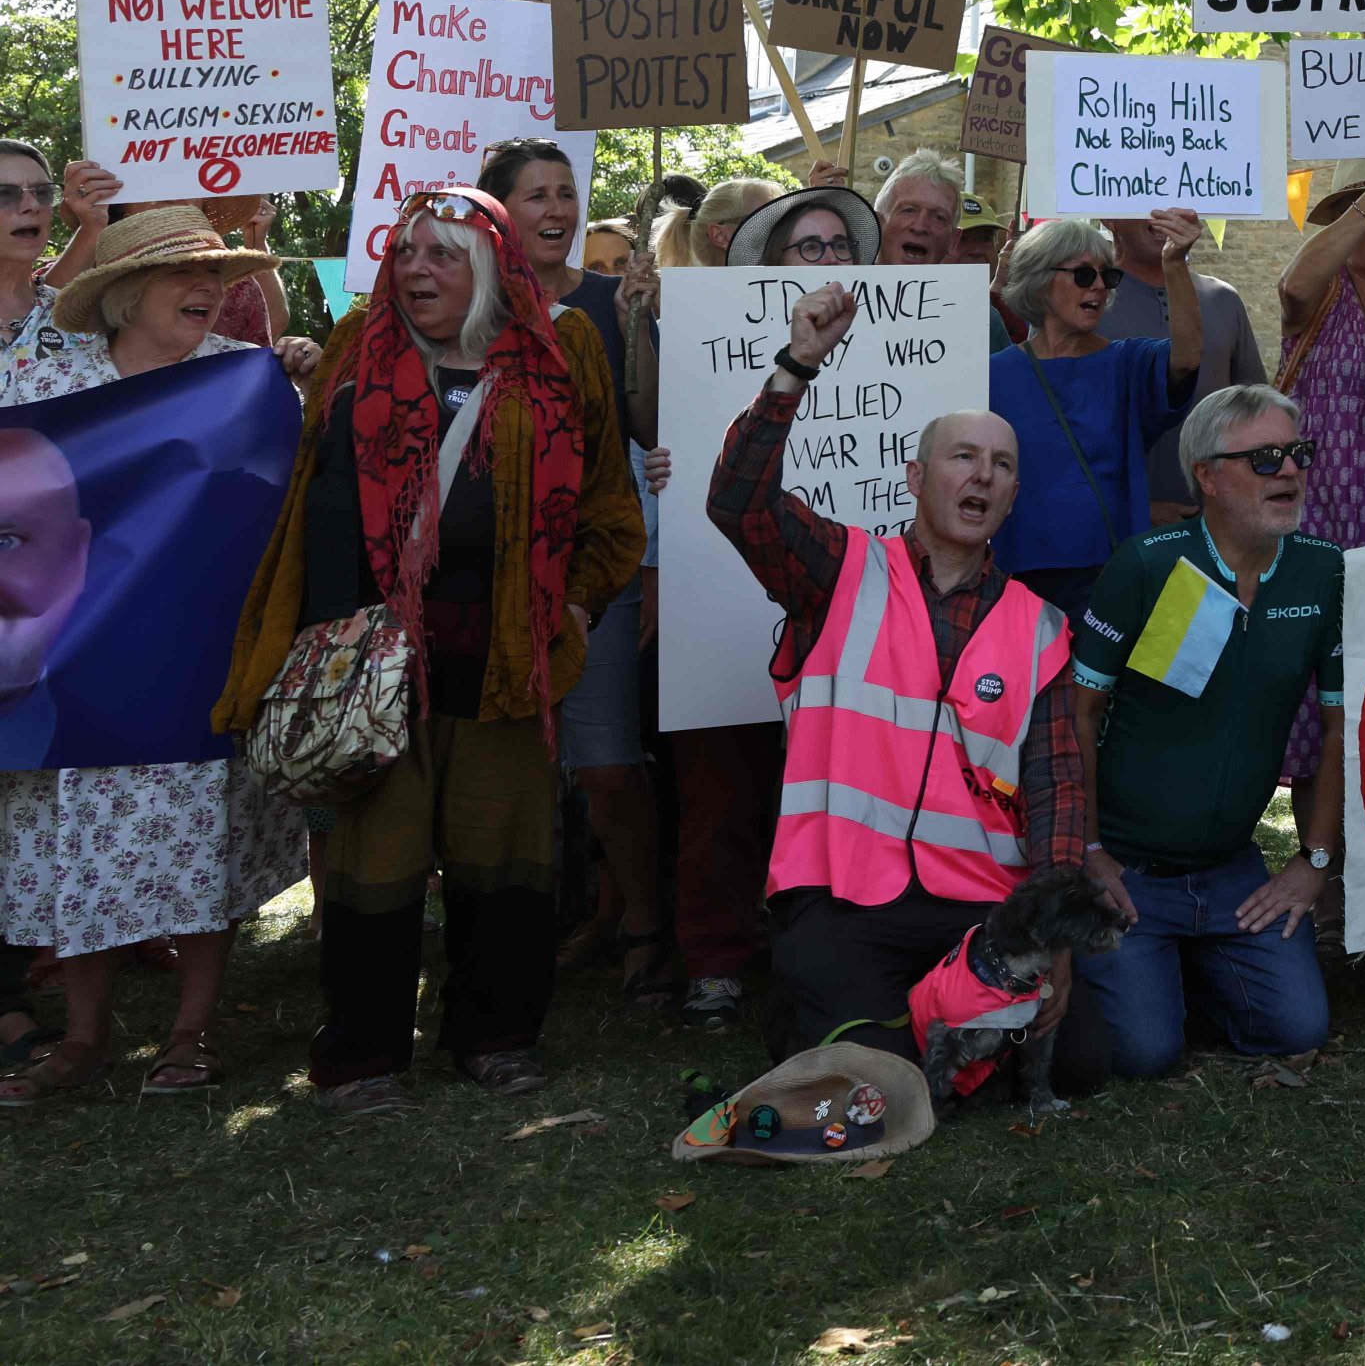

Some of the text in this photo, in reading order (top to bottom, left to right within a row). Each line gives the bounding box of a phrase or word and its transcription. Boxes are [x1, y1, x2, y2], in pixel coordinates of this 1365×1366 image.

[393, 0, 487, 42] Make
[836, 15, 917, 54] NOW
[160, 28, 245, 61] HERE
[128, 64, 261, 90] BULLYING
[386, 50, 555, 120] Charlbury
[575, 52, 737, 120] PROTEST
[976, 71, 1014, 98] TO
[123, 101, 313, 131] RACISM SEXISM
[972, 103, 999, 117] and
[1079, 77, 1156, 127] Rolling
[1171, 82, 1232, 123] Hills
[380, 109, 477, 154] Great
[969, 116, 1024, 137] RACIST
[1075, 127, 1228, 156] Not Rolling Back
[120, 130, 336, 164] NOT WELCOME HERE
[969, 136, 1018, 153] rhetoric
[1071, 161, 1253, 198] Climate Action!
[702, 336, 946, 372] THE WHO
[788, 434, 857, 469] WAR
[855, 481, 912, 512] THE
[1143, 530, 1191, 546] SKODA
[1293, 535, 1341, 552] SKODA
[1084, 607, 1124, 644] Santini
[1266, 604, 1321, 619] SKODA
[977, 684, 1002, 695] TRUMP
[981, 678, 1001, 687] STOP
